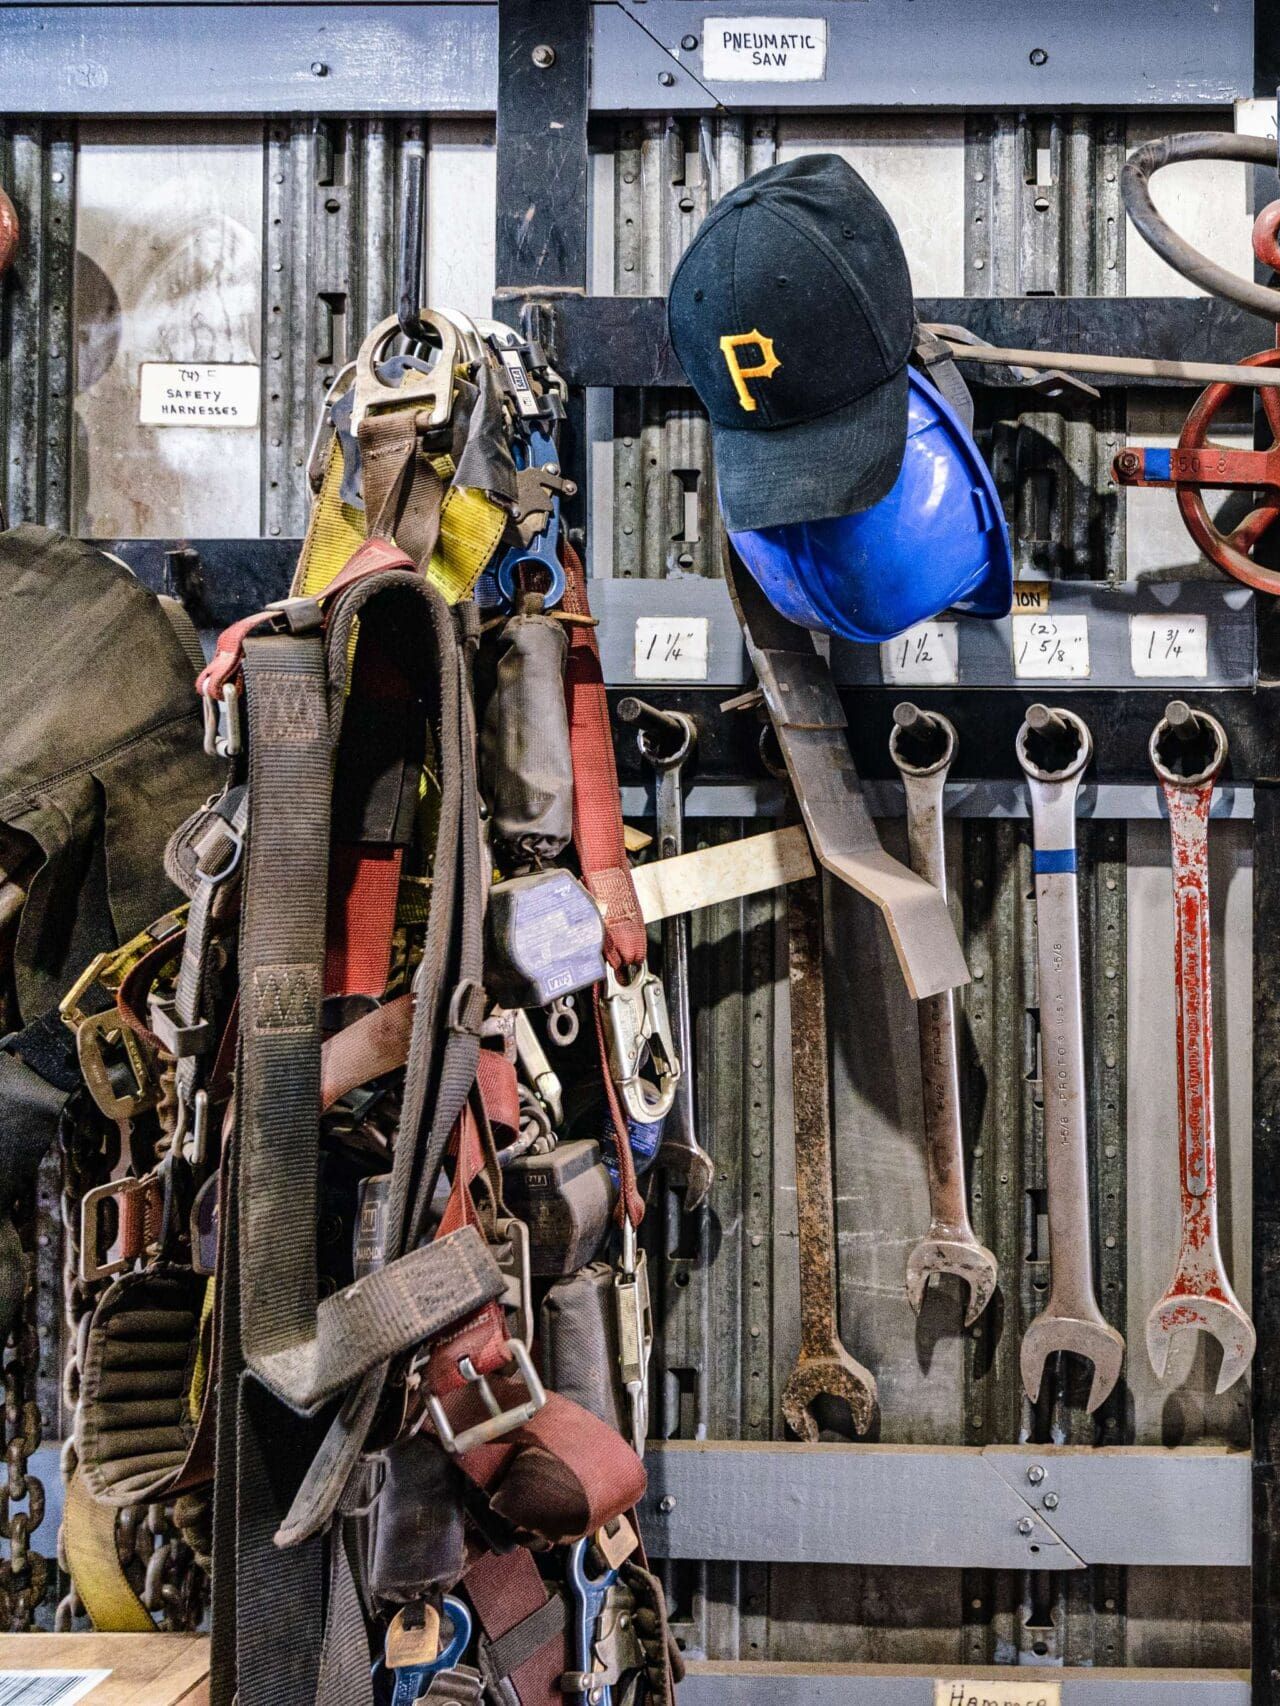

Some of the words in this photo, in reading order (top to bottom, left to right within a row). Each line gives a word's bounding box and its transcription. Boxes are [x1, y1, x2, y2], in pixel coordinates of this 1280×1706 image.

[723, 31, 815, 50] PNEUMATIC
[752, 51, 787, 66] SAW
[720, 328, 782, 411] P
[166, 388, 222, 402] SAFETY
[161, 404, 239, 416] HARNESSES
[1031, 623, 1058, 636] (2)
[1053, 943, 1063, 972] 1-5/8
[1060, 1115, 1070, 1146] 1-5/8
